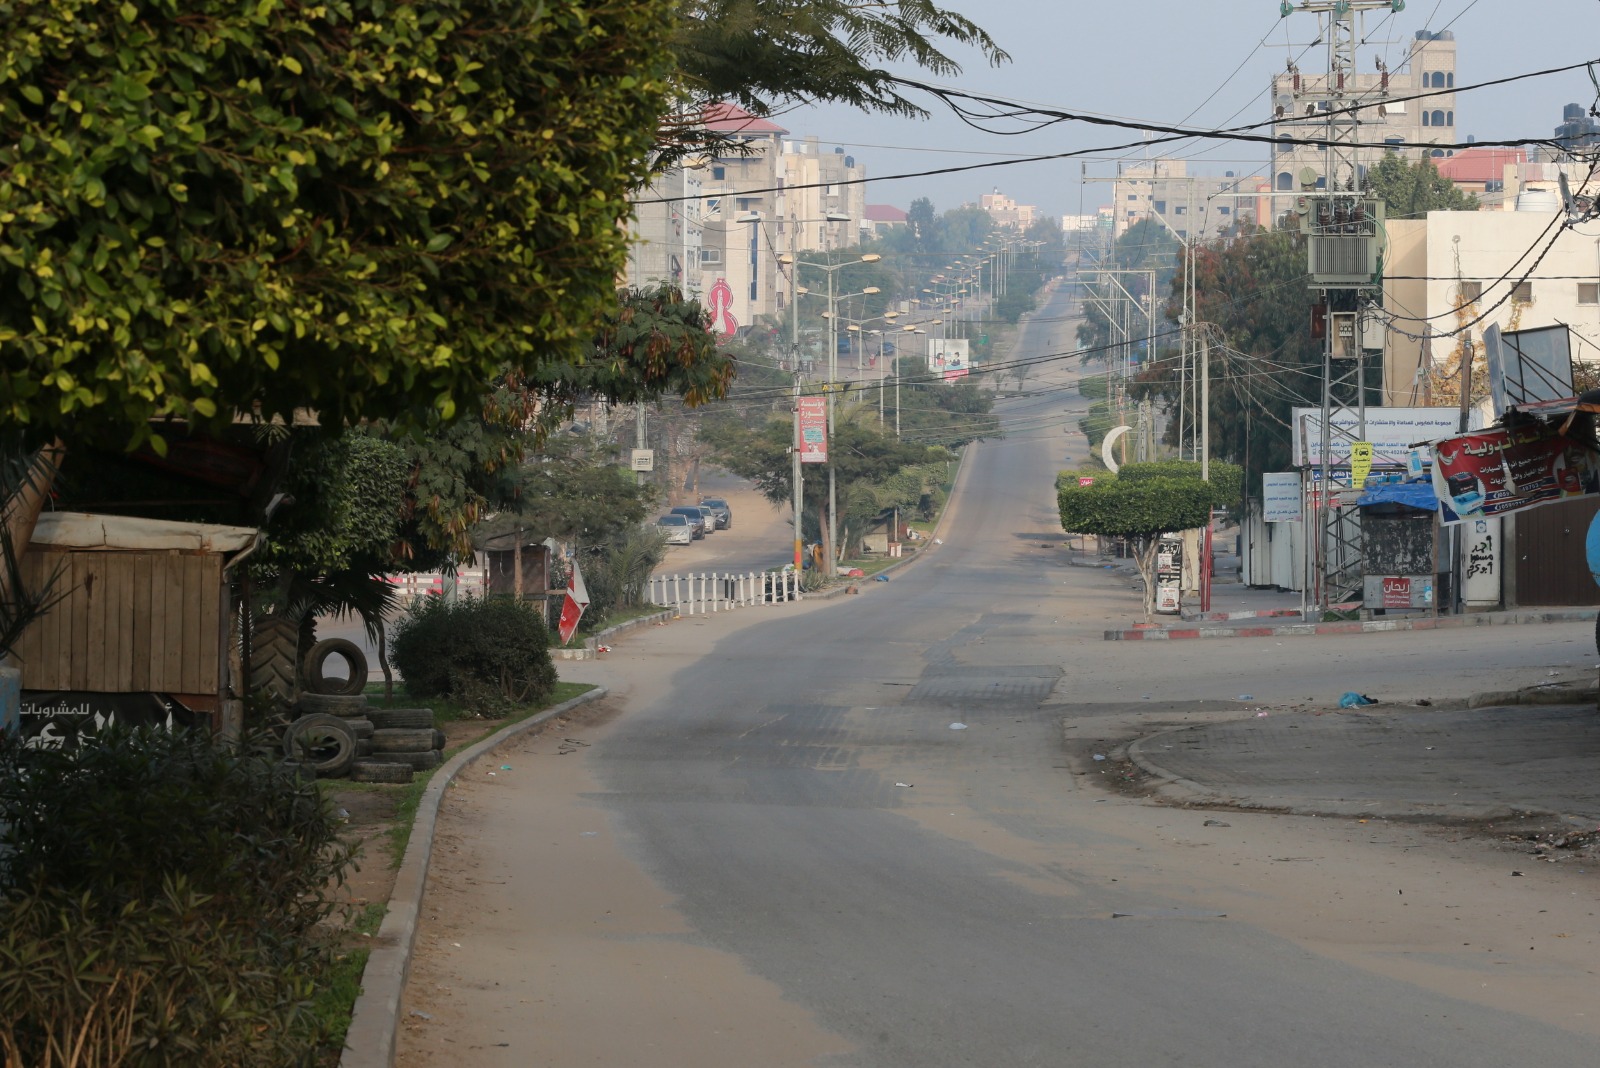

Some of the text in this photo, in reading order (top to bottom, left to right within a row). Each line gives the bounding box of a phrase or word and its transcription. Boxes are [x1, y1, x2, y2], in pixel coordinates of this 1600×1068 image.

[1462, 436, 1516, 458] الدولية
[1383, 580, 1410, 594] ريحان
[19, 699, 90, 720] للمشروبات
